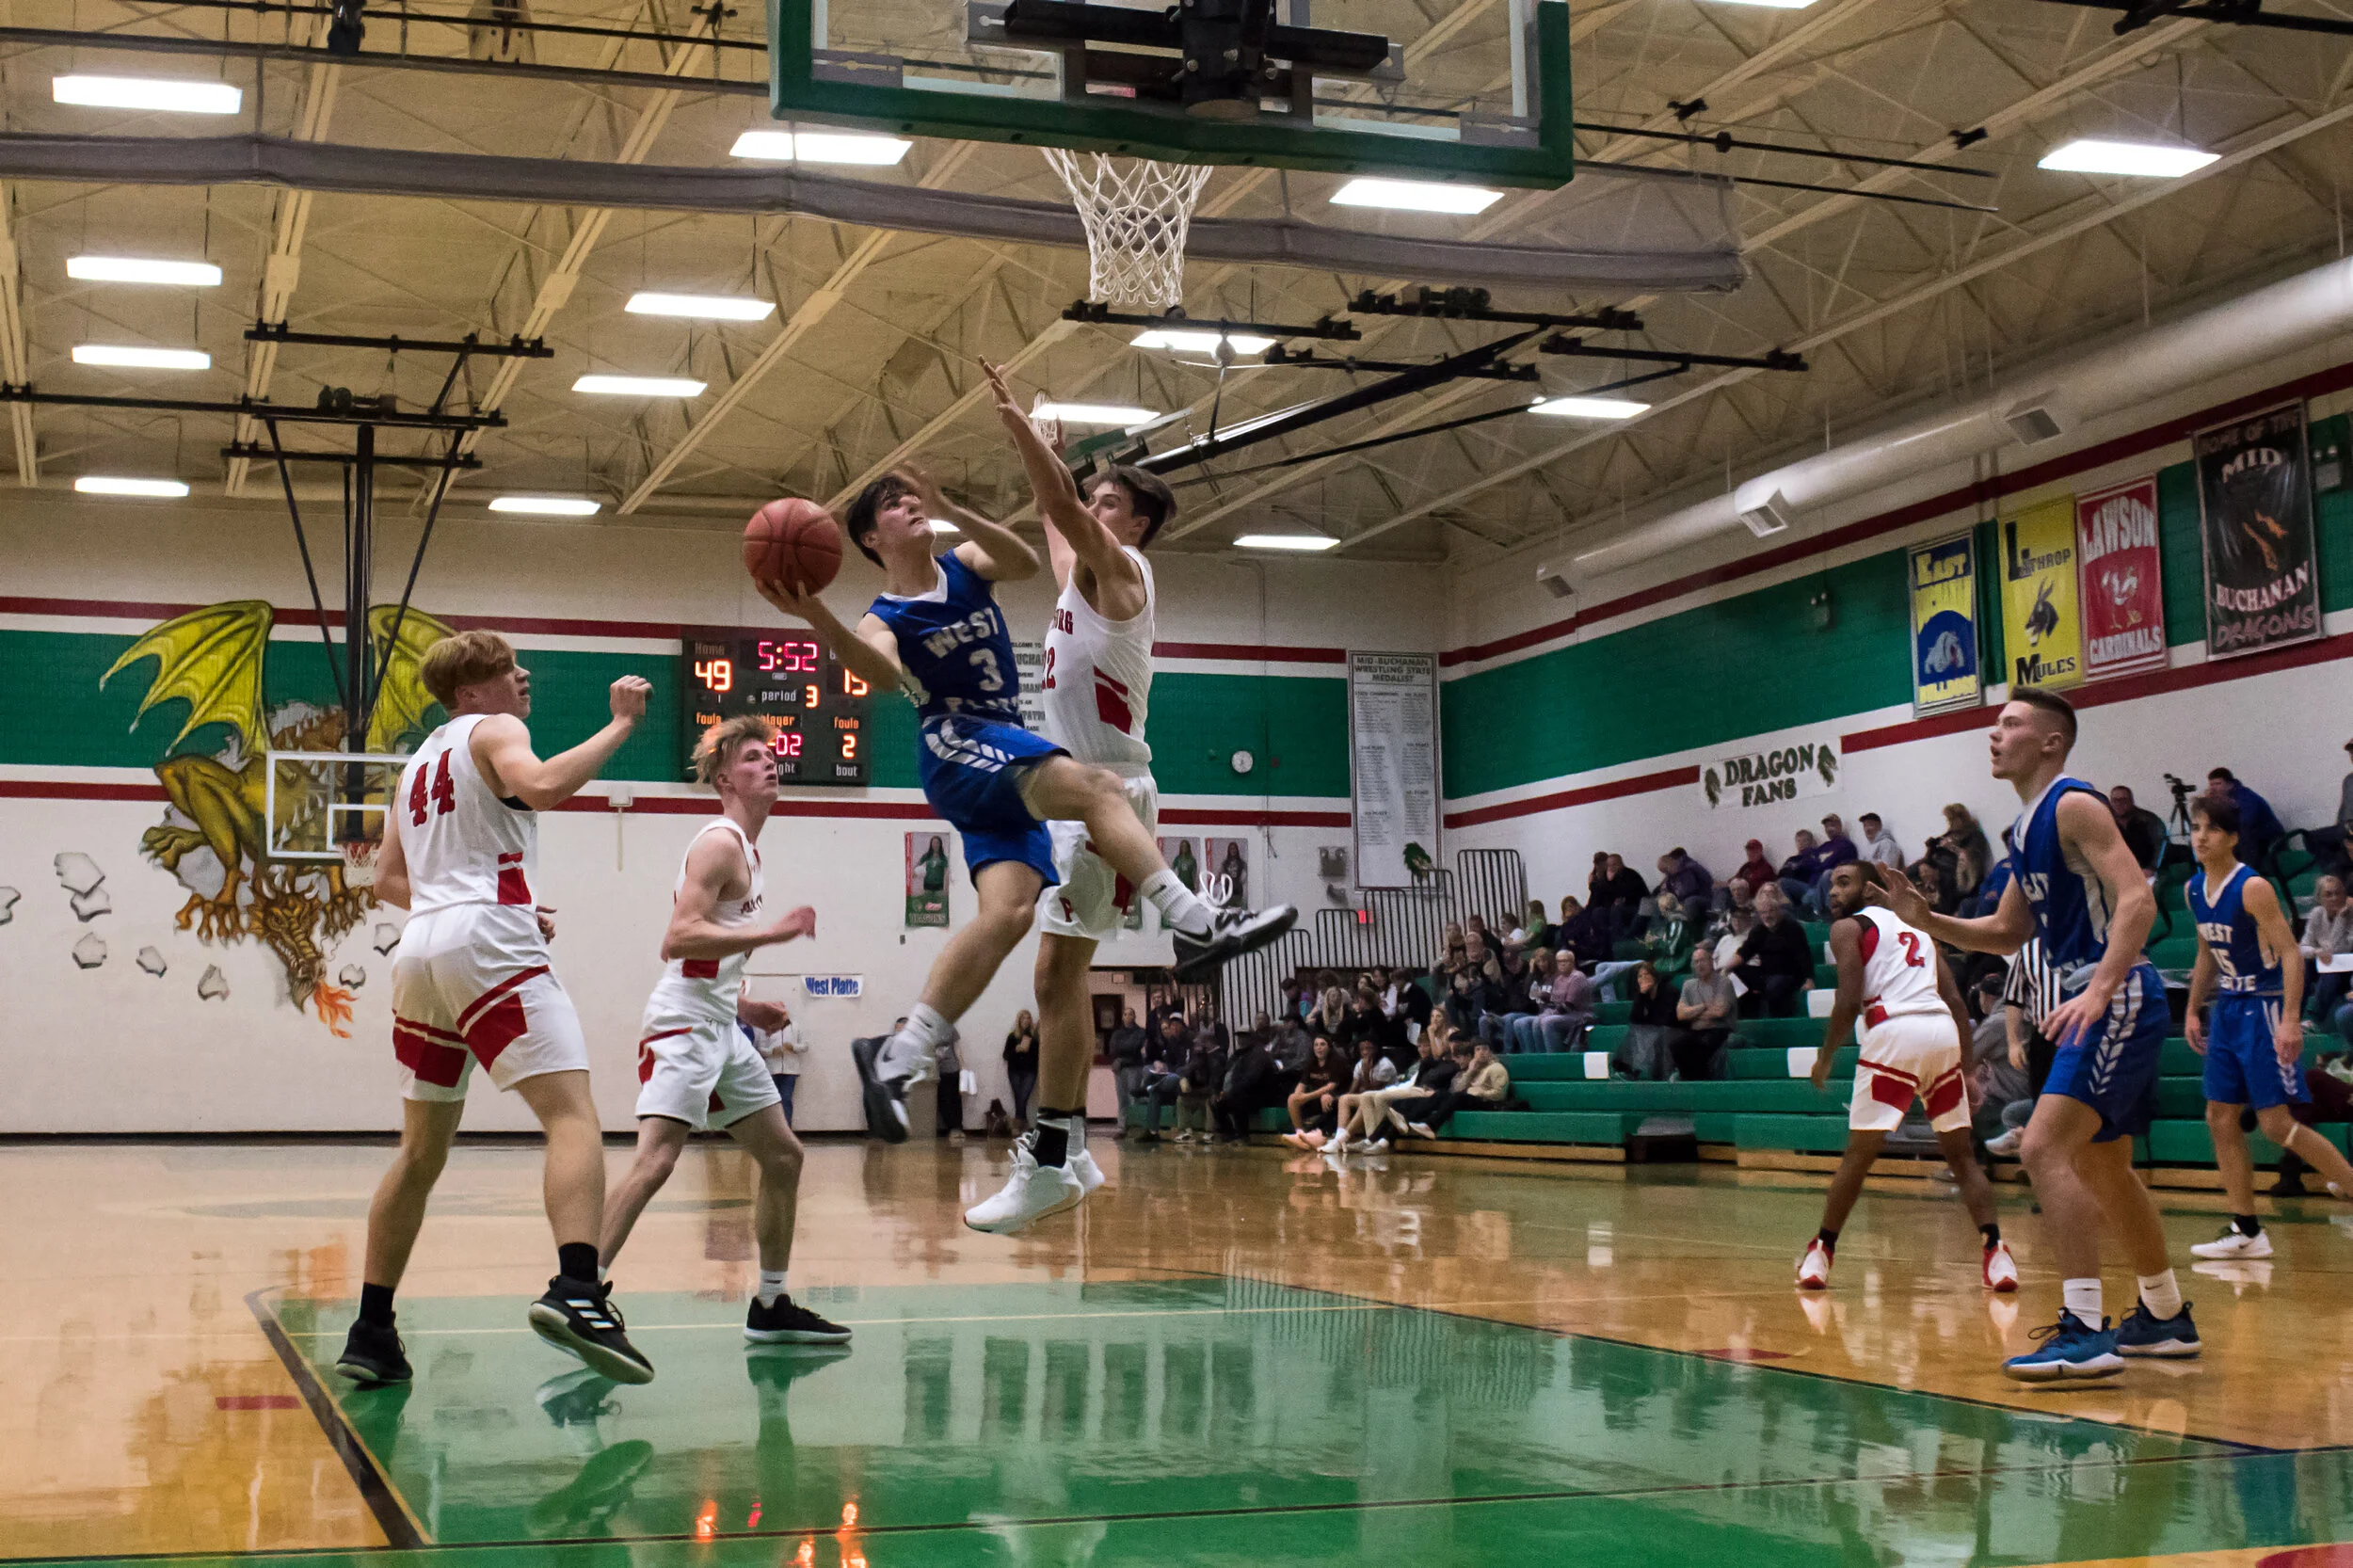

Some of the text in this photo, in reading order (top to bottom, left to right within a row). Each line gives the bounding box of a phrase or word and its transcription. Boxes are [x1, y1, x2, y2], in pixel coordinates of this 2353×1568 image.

[2222, 447, 2281, 484] MID
[2083, 496, 2155, 565] LAWSON
[1916, 553, 1966, 586] EAST
[2217, 560, 2309, 612] BUCHANAN
[922, 607, 999, 658] WEST
[2216, 605, 2314, 648] DRAGONS
[696, 643, 725, 655] Home
[759, 641, 818, 671] 5:52
[2089, 625, 2161, 664] CARDINALS
[695, 660, 732, 692] 49
[968, 648, 1004, 692] 3
[1355, 664, 1403, 674] WRESTLING
[2016, 653, 2076, 685] MULES
[761, 684, 819, 709] period 3
[696, 712, 721, 725] fouls
[834, 716, 859, 729] fouls
[841, 734, 856, 760] 2
[836, 763, 857, 776] bout
[1724, 743, 1815, 787] DRAGON
[408, 747, 456, 827] 44
[1742, 777, 1797, 807] FANS
[2197, 922, 2233, 944] WEST
[1897, 931, 1925, 968] 2
[805, 977, 858, 995] West Platte
